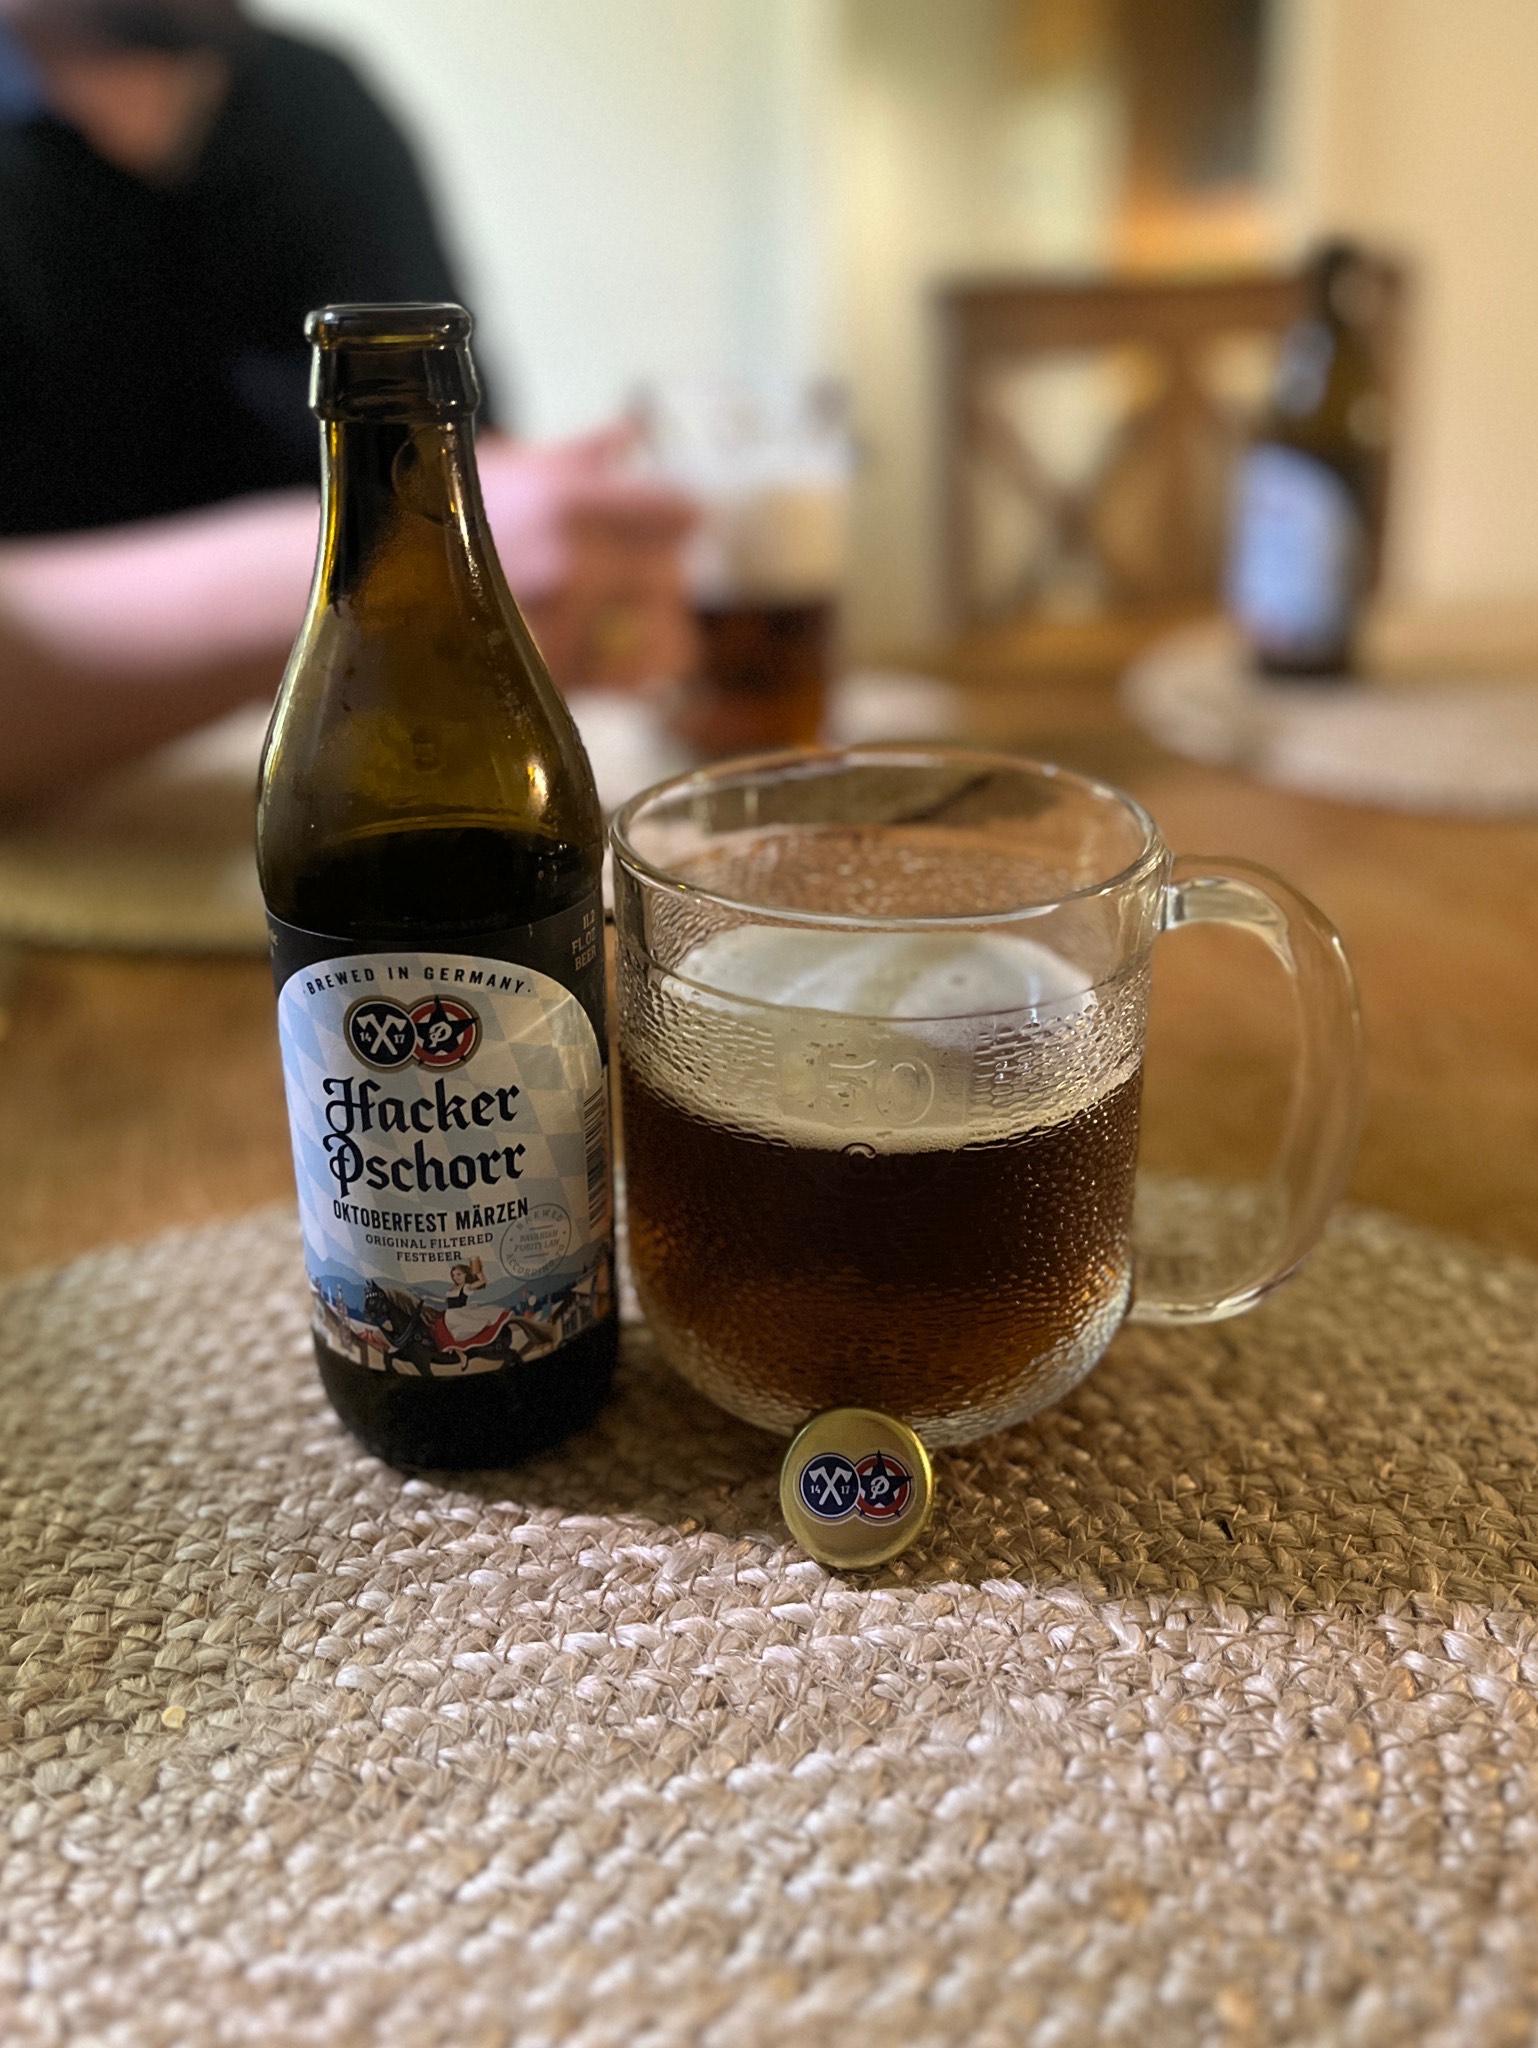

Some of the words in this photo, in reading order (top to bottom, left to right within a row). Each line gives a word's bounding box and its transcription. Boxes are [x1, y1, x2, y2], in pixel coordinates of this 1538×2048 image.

[574, 944, 597, 971] BEER
[388, 966, 409, 980] IN
[359, 1031, 372, 1043] 14
[393, 1034, 406, 1044] 17
[322, 1076, 520, 1134] Hacker
[322, 1133, 526, 1199] Pschorr
[333, 1199, 448, 1233] OKTOBERFEST
[455, 1197, 528, 1231] MÄRZEN
[365, 1233, 426, 1249] ORIGINAL
[430, 1232, 493, 1249] FILTERED
[396, 1250, 462, 1262] FESTBEER
[809, 1483, 821, 1495] 14
[840, 1485, 851, 1495] 17
